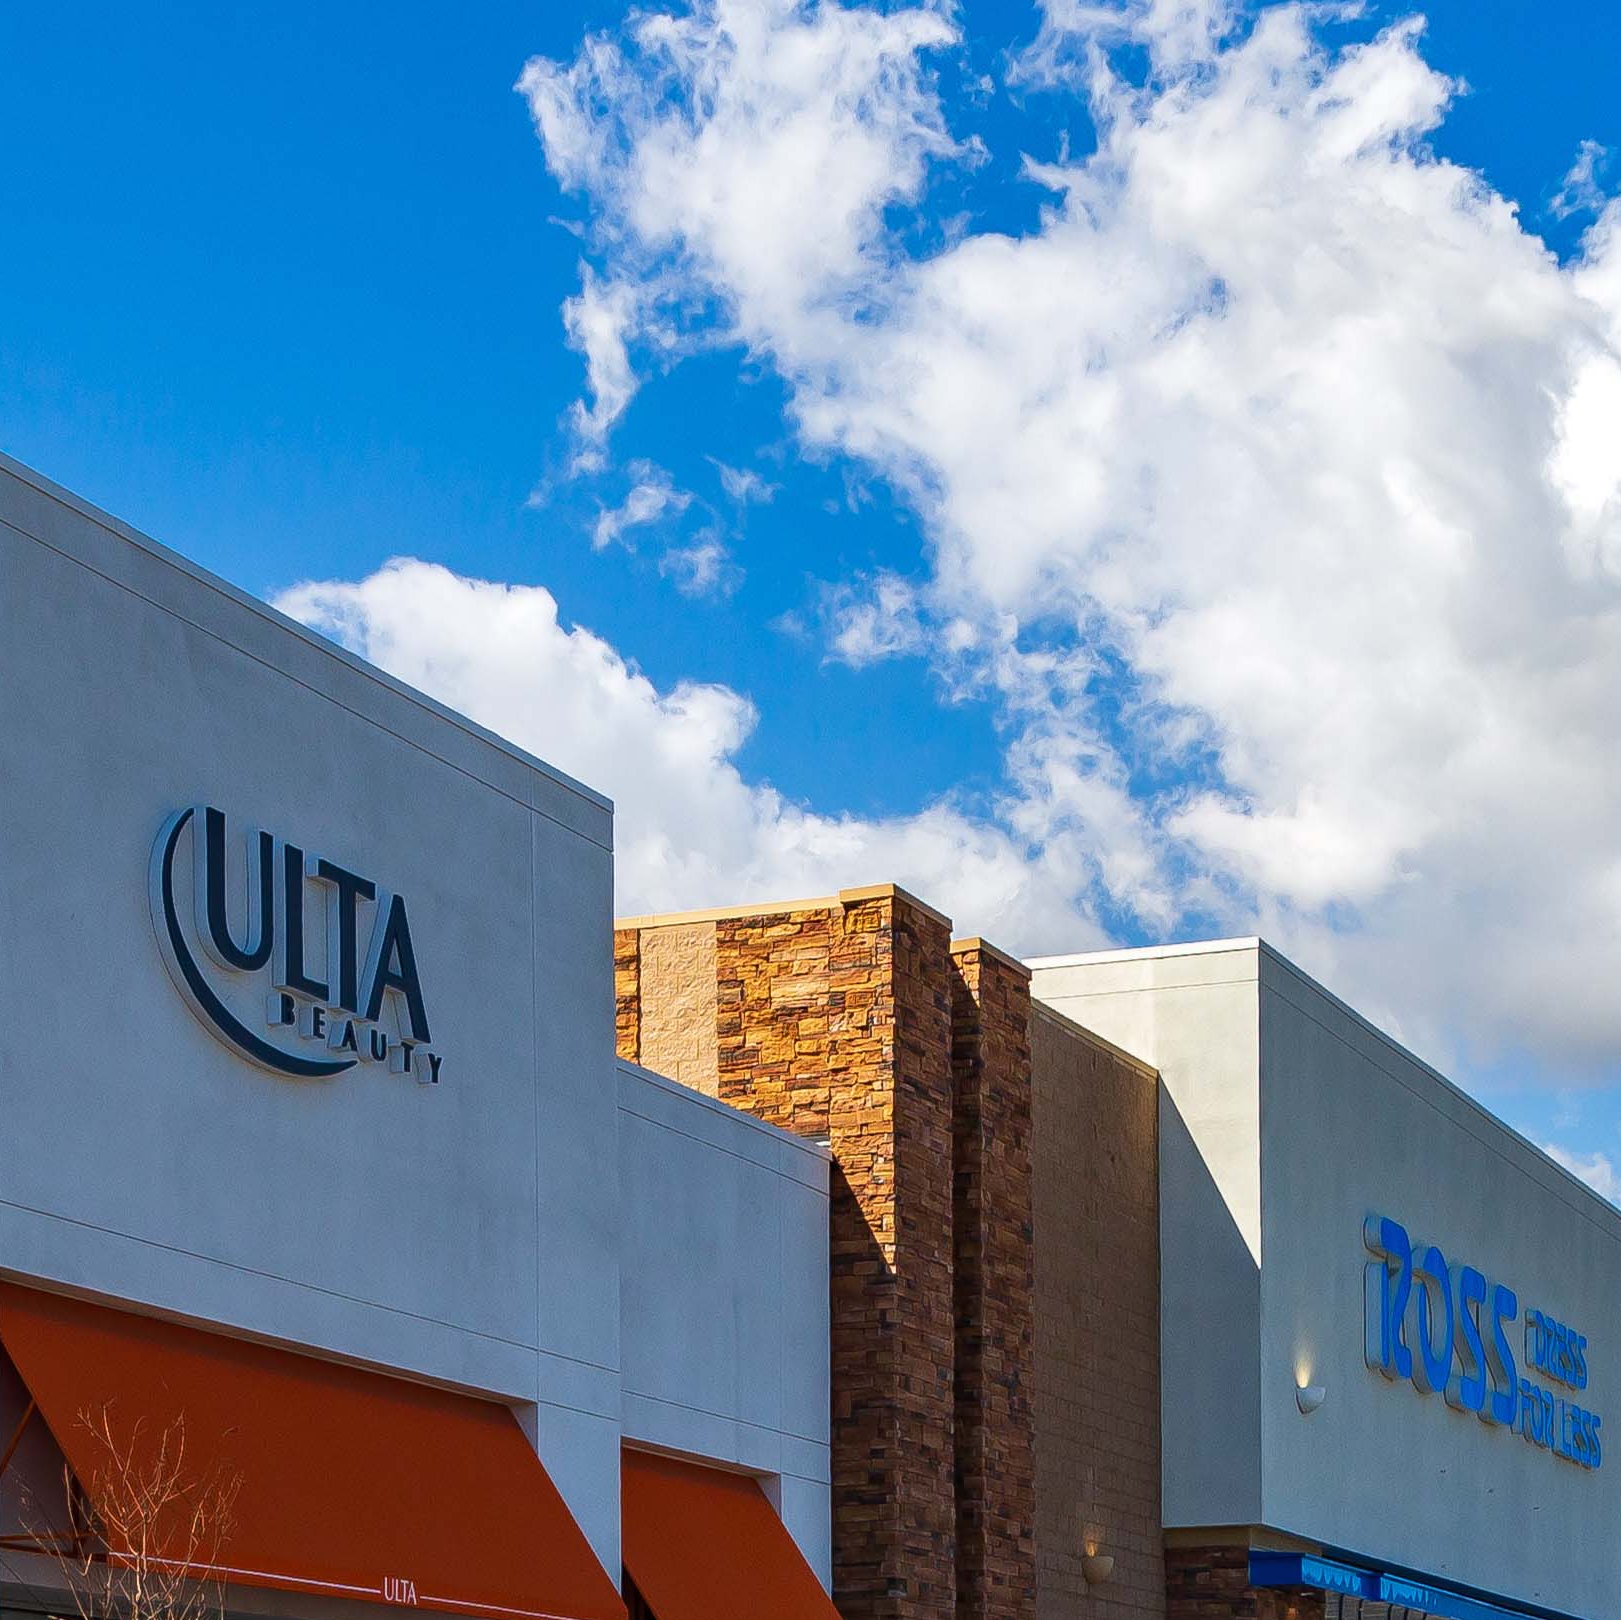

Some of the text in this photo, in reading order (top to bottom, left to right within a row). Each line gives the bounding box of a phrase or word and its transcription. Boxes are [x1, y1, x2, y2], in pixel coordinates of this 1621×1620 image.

[195, 804, 433, 1046] ULTA
[272, 992, 444, 1085] BEAUTY
[1366, 1216, 1518, 1427] ROSS
[1527, 1309, 1588, 1390] DRESS
[1517, 1378, 1602, 1469] FOR LESS
[384, 1576, 418, 1606] ULTA
